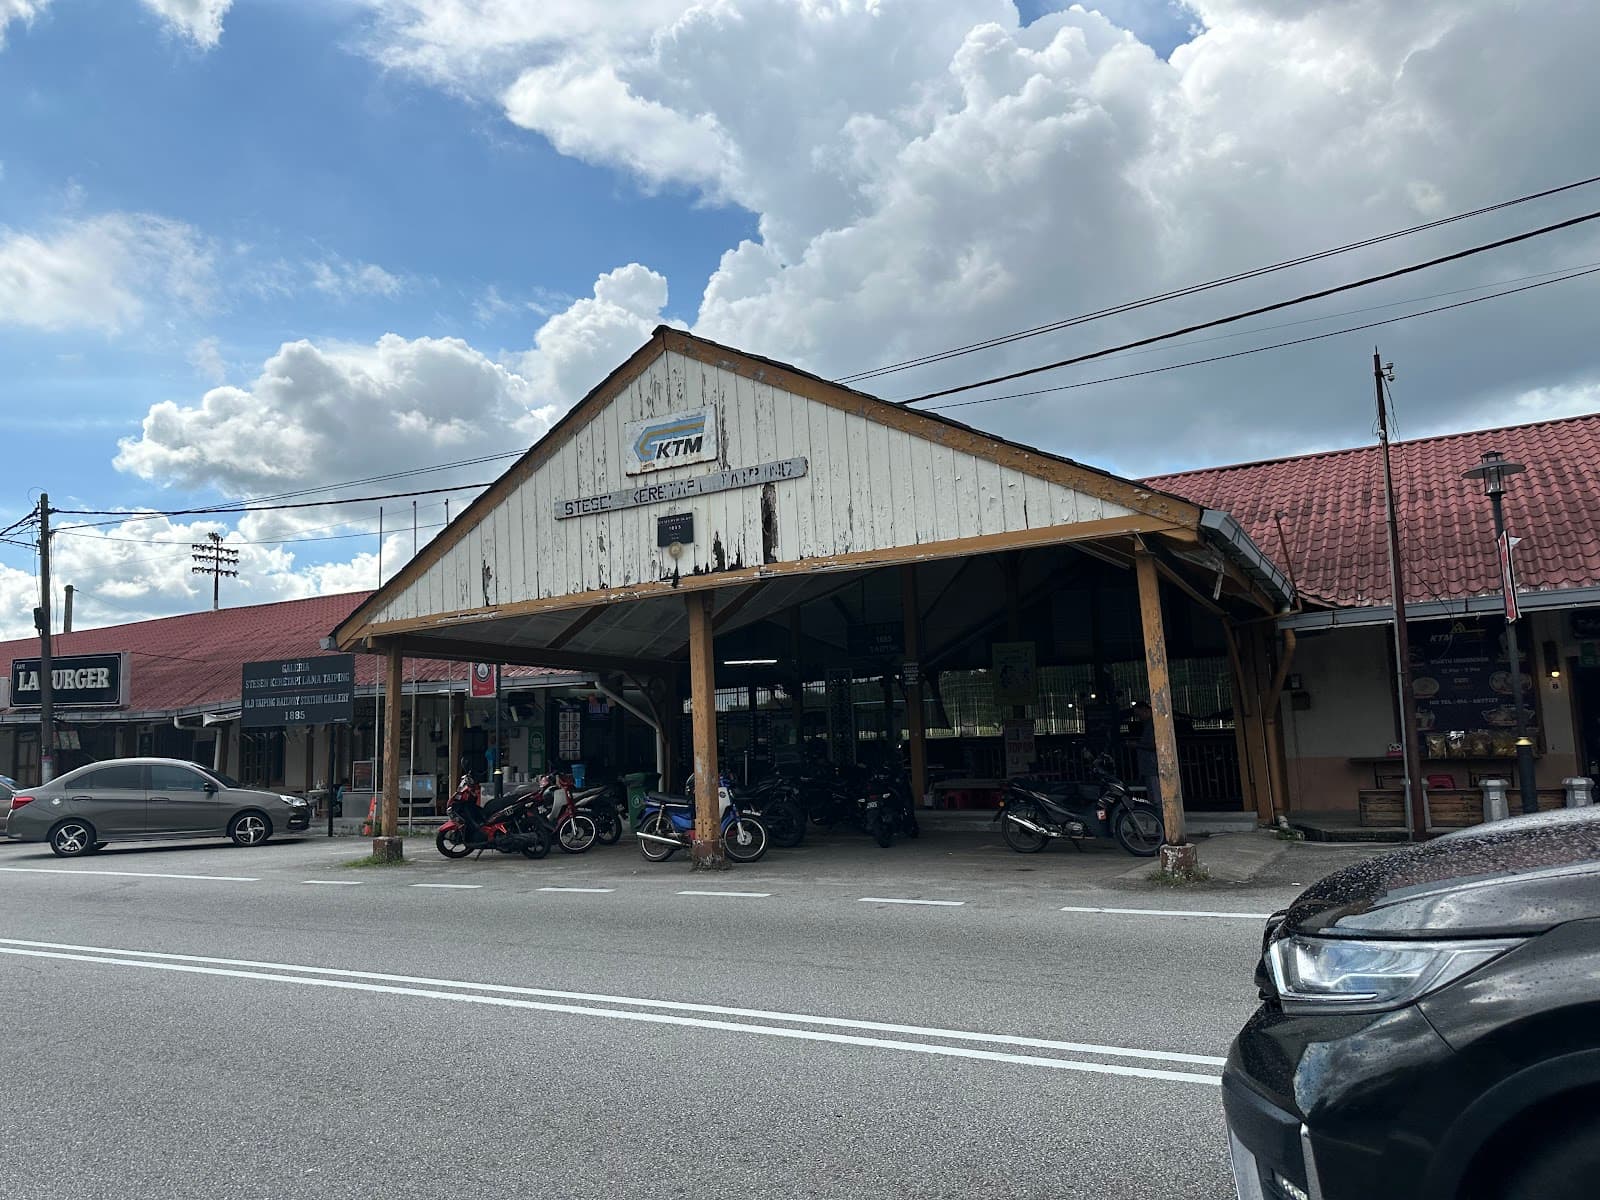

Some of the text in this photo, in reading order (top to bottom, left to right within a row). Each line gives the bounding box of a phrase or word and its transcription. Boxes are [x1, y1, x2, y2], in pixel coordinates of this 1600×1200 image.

[656, 435, 703, 460] KTM
[565, 494, 616, 516] STESE
[18, 667, 110, 692] LA URGER
[323, 672, 350, 683] TAIPING
[284, 710, 306, 720] 1885
